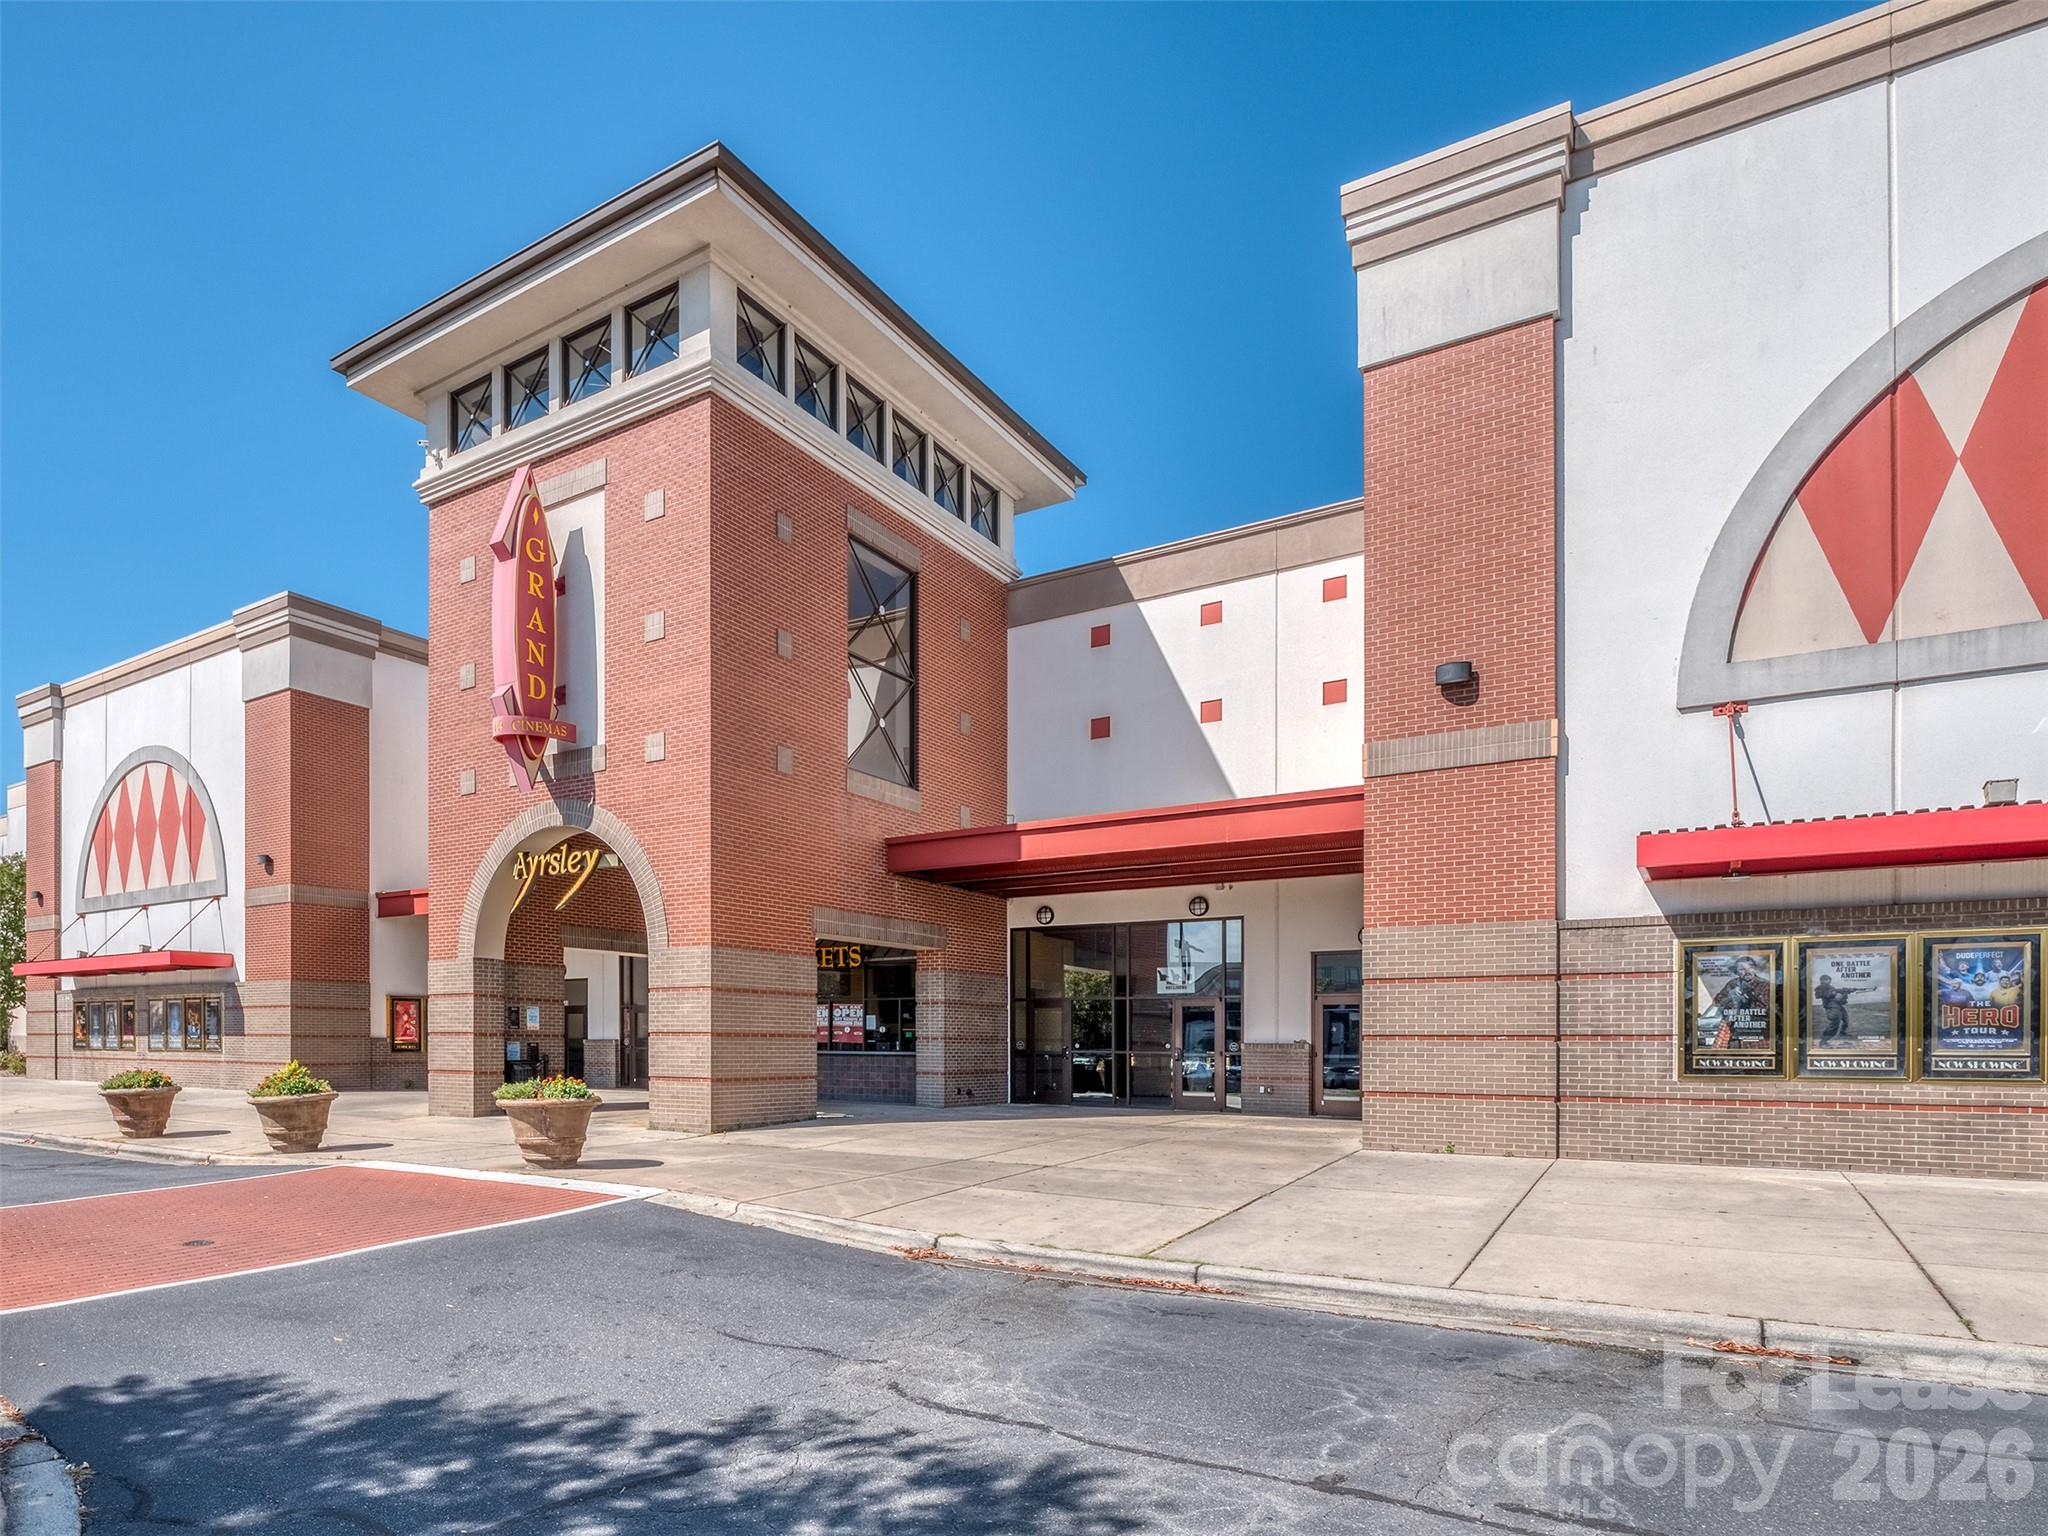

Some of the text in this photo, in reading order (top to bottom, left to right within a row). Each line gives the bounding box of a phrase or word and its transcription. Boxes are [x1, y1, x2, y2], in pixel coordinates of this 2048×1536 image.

[525, 537, 547, 700] GRAND
[512, 719, 568, 737] CINEMAS
[510, 843, 600, 914] Ayrsley
[816, 945, 861, 968] ETS
[833, 1008, 863, 1017] OPEN
[1723, 1008, 1767, 1016] ONE BATTLE
[1941, 1004, 2020, 1029] HERO
[1733, 1021, 1767, 1029] ANOTHER
[1963, 1027, 1997, 1035] TOUR
[1699, 1059, 1768, 1068] NOW SHOWING
[1813, 1060, 1888, 1068] NOW SHOWING
[1938, 1061, 2020, 1070] NOW SHOWING
